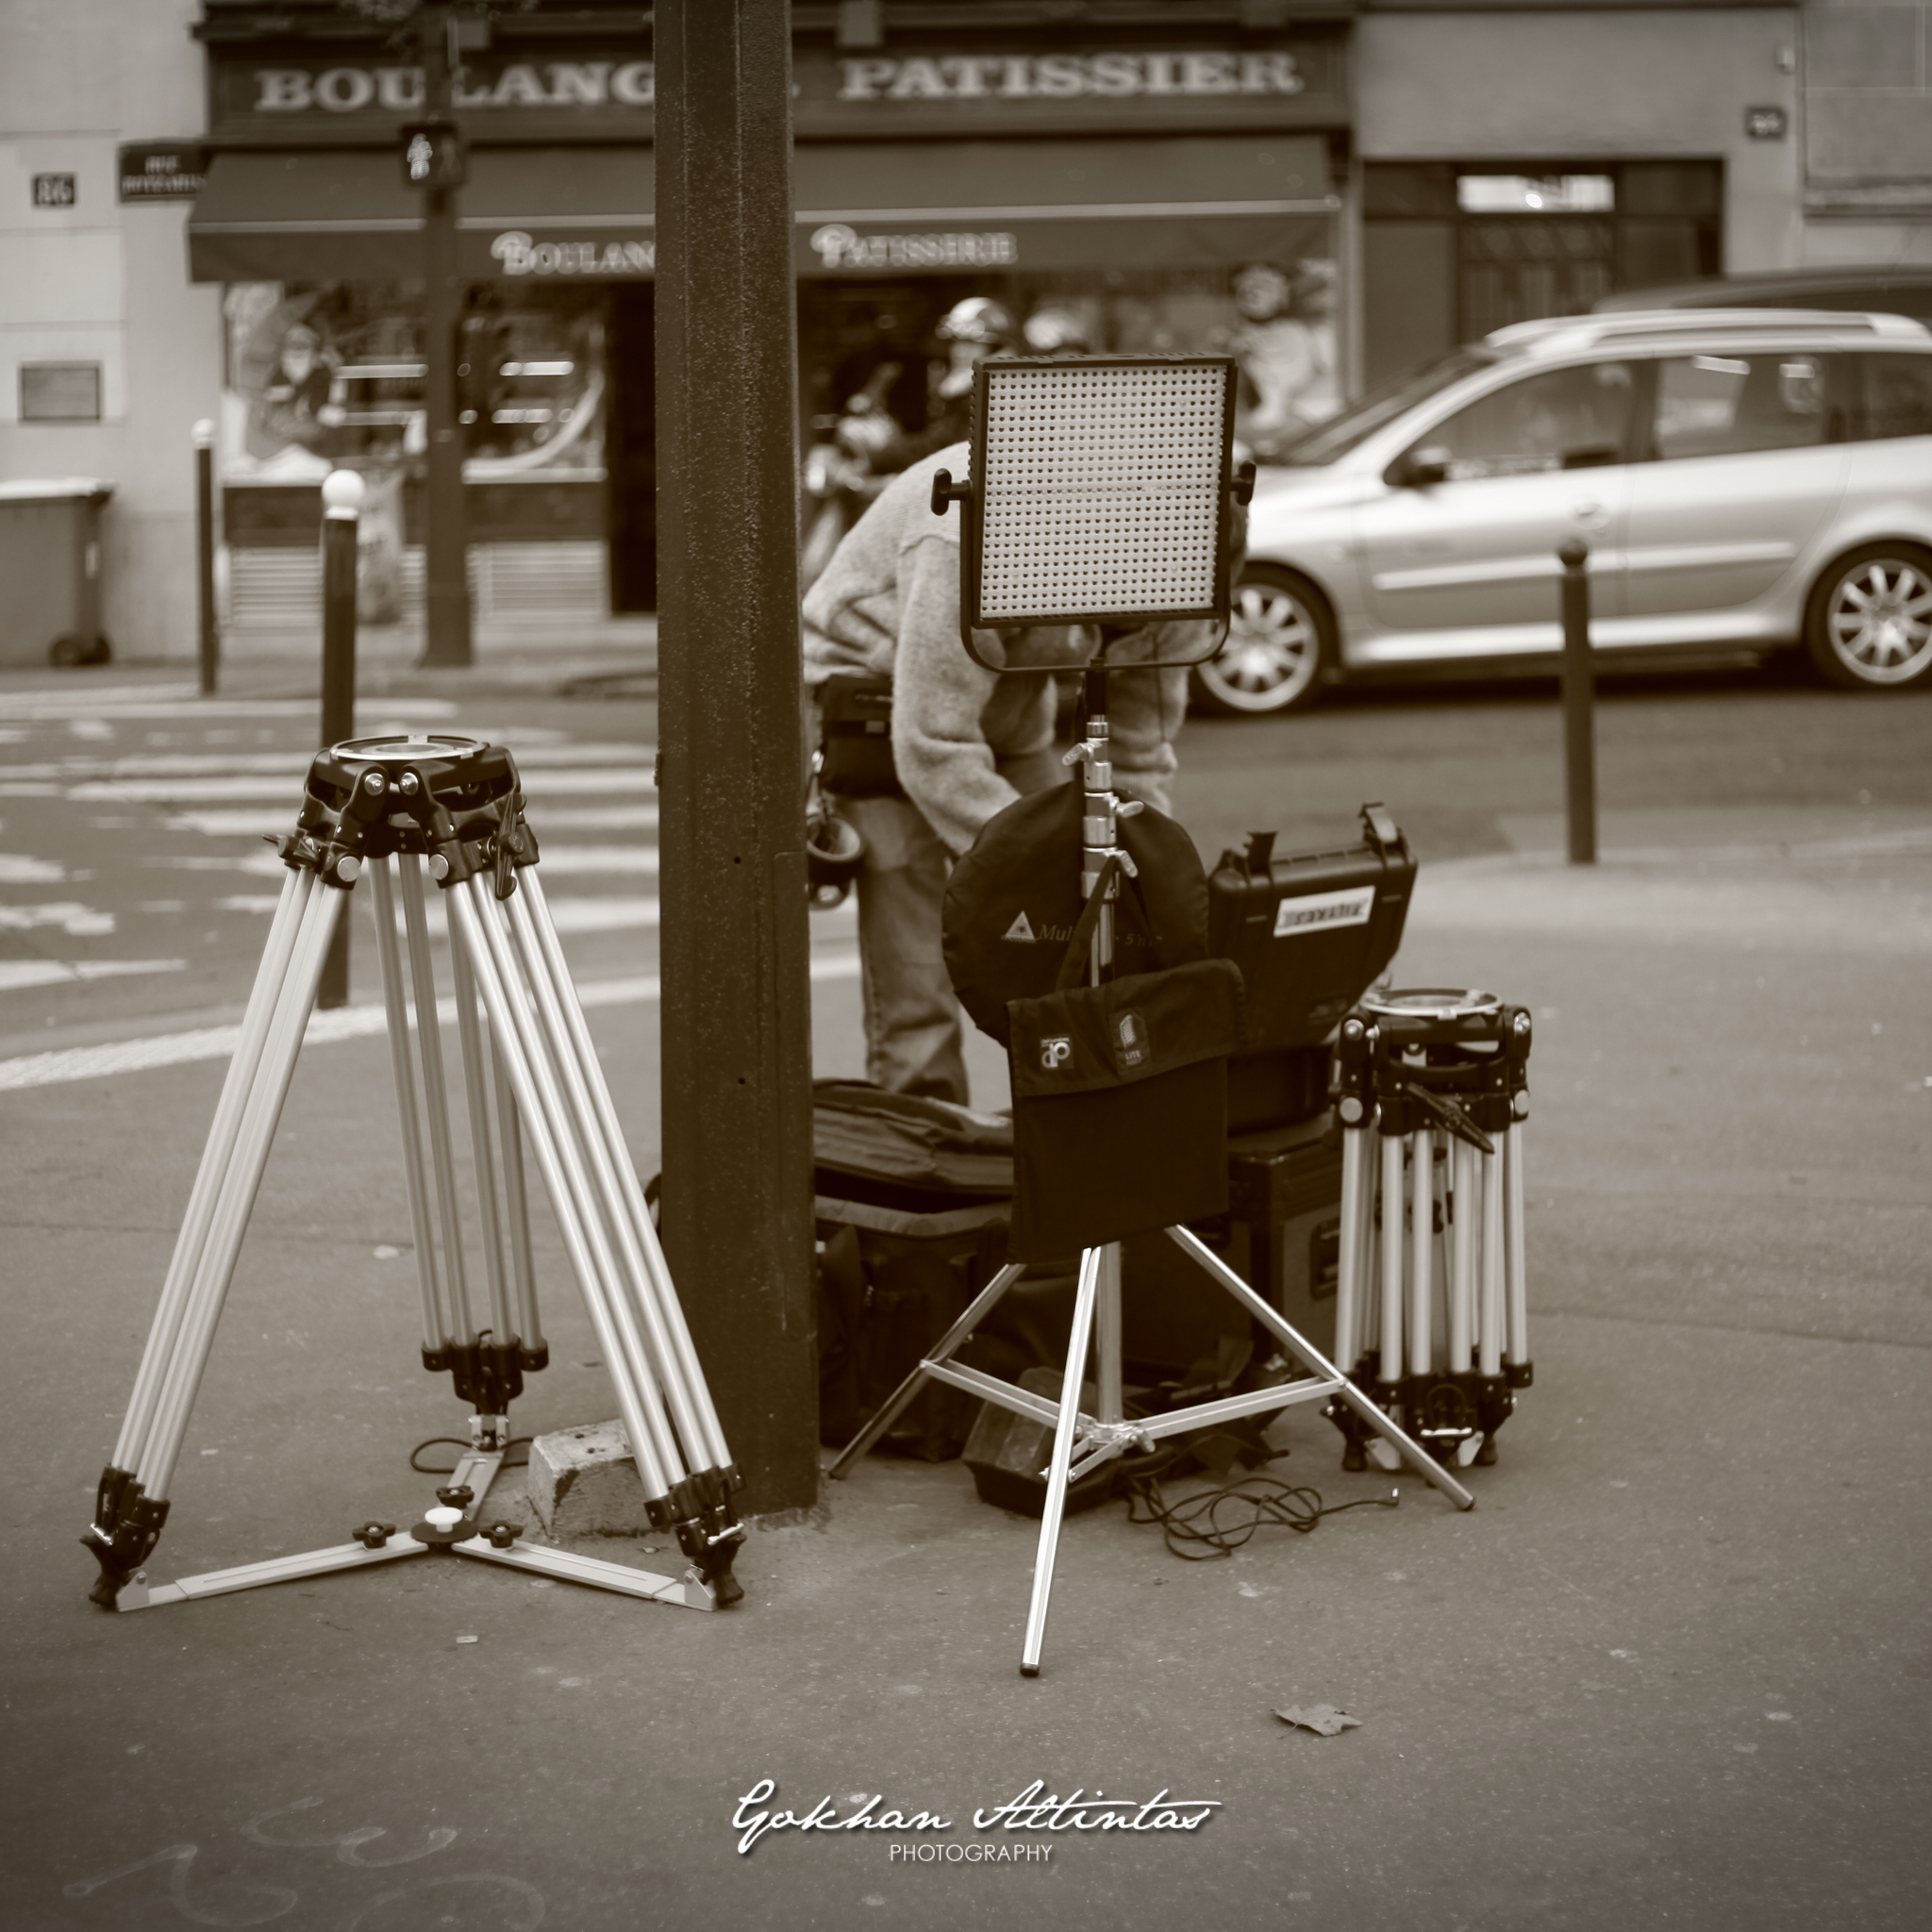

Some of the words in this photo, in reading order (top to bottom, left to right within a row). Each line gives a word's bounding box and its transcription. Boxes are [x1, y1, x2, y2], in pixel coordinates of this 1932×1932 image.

[254, 61, 800, 112] BOULANG
[837, 52, 1305, 101] PATISSIER
[490, 230, 655, 275] BOULAN
[1124, 1049, 1141, 1060] LITE
